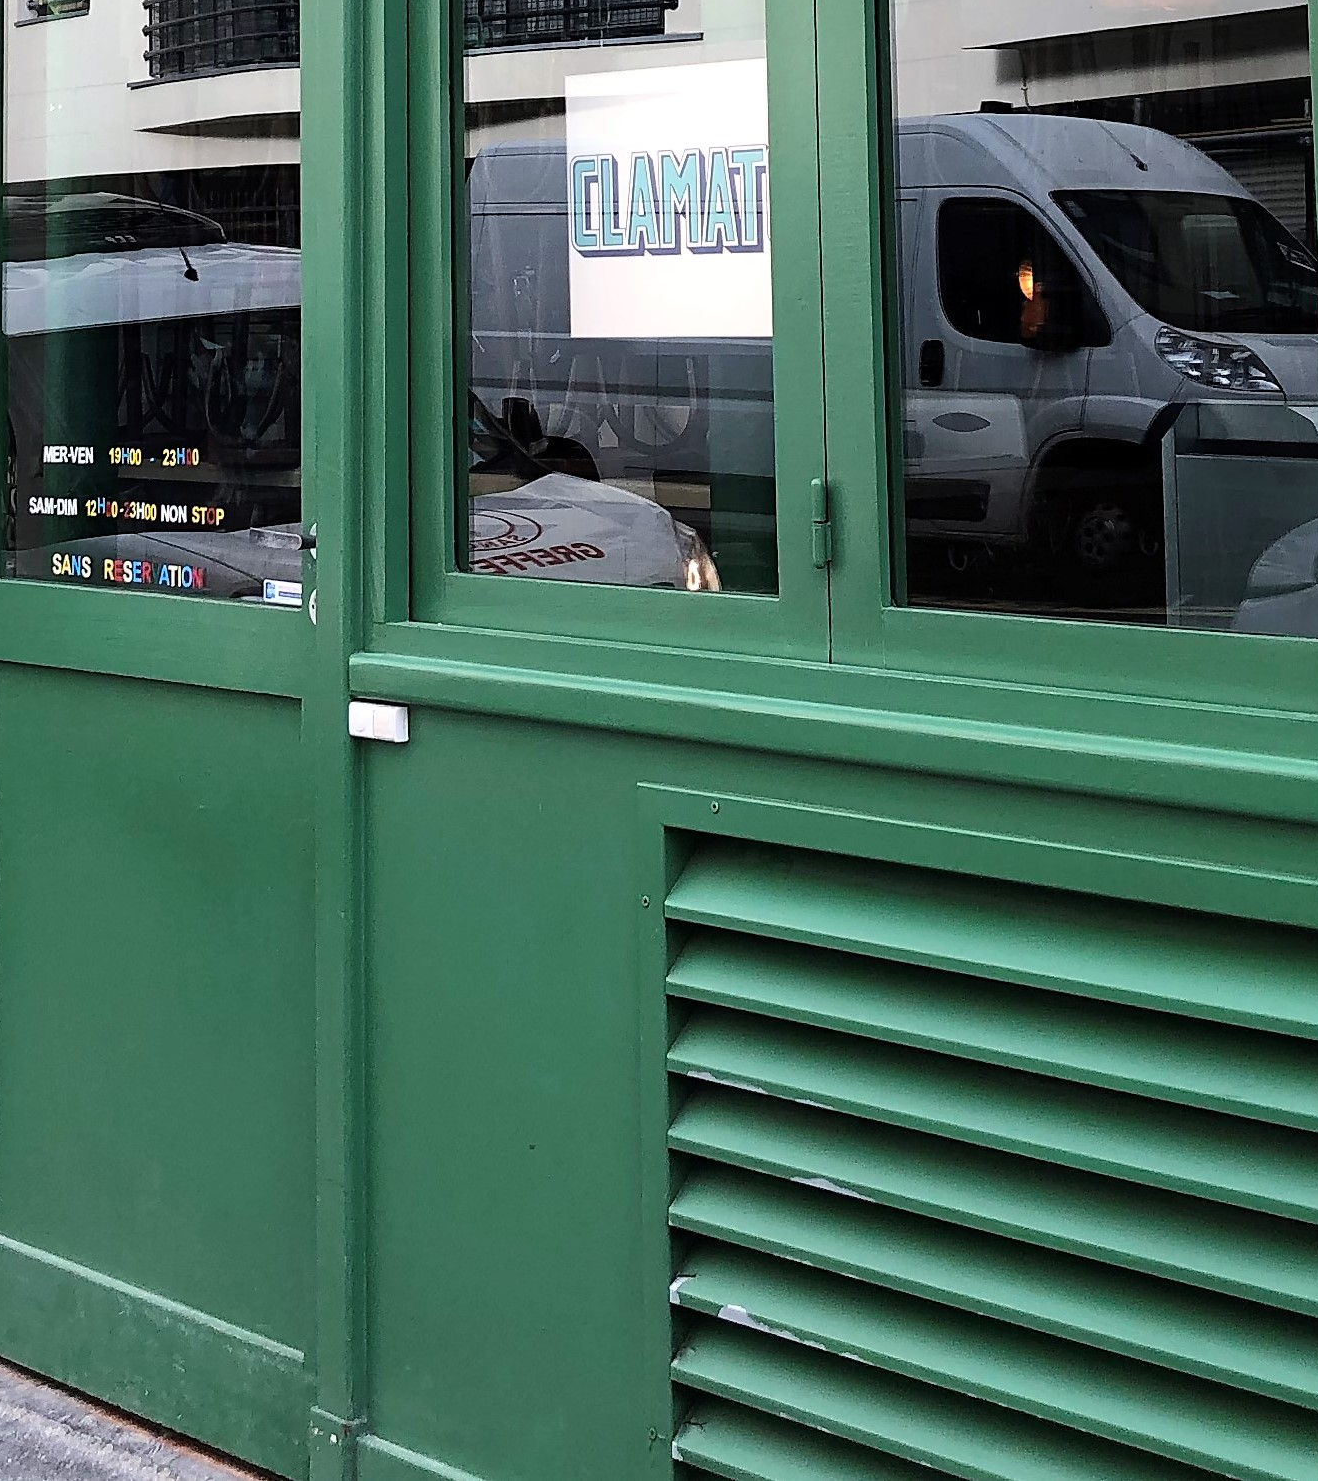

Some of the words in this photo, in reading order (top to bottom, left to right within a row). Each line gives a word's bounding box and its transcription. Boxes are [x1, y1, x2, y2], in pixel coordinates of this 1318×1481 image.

[570, 144, 770, 258] CLAMAT
[42, 445, 95, 465] MER-VEN
[108, 447, 143, 466] 19H00
[162, 447, 200, 467] 23H00
[28, 496, 78, 516] SAM-DIM
[160, 504, 188, 524] NON
[191, 505, 225, 527] STOP
[52, 552, 92, 578] SANS
